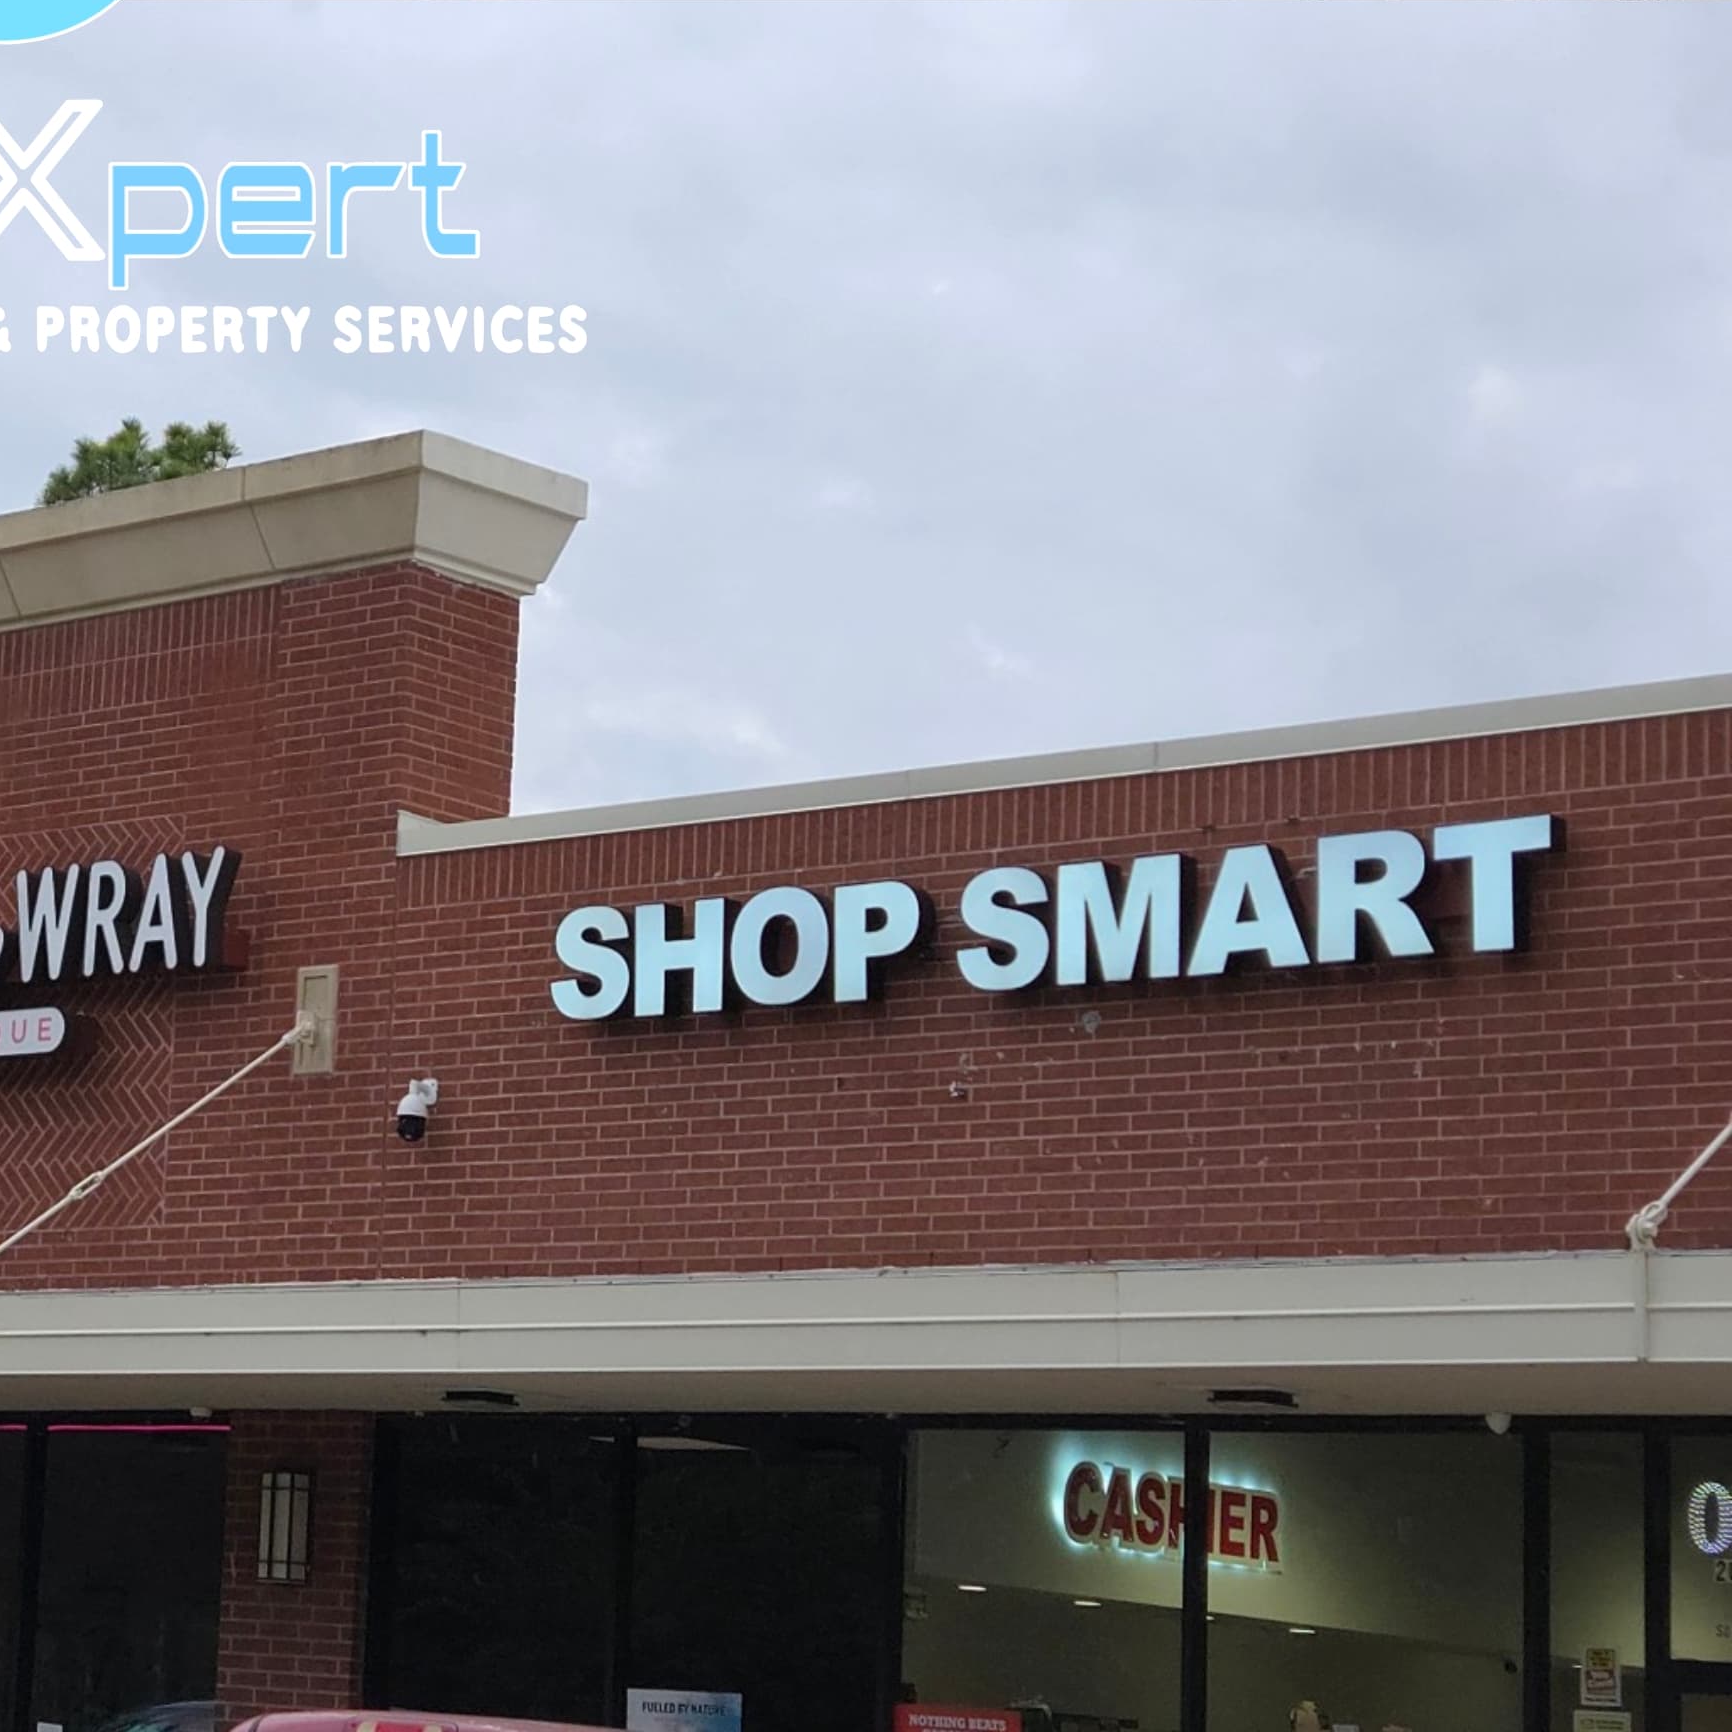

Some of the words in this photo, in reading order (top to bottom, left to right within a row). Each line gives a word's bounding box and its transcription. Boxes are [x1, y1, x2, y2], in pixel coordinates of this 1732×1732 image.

[16, 846, 226, 982] WRAY
[550, 880, 920, 1021] SHOP
[956, 814, 1552, 992] SMART
[908, 1714, 966, 1729] NOTHING
